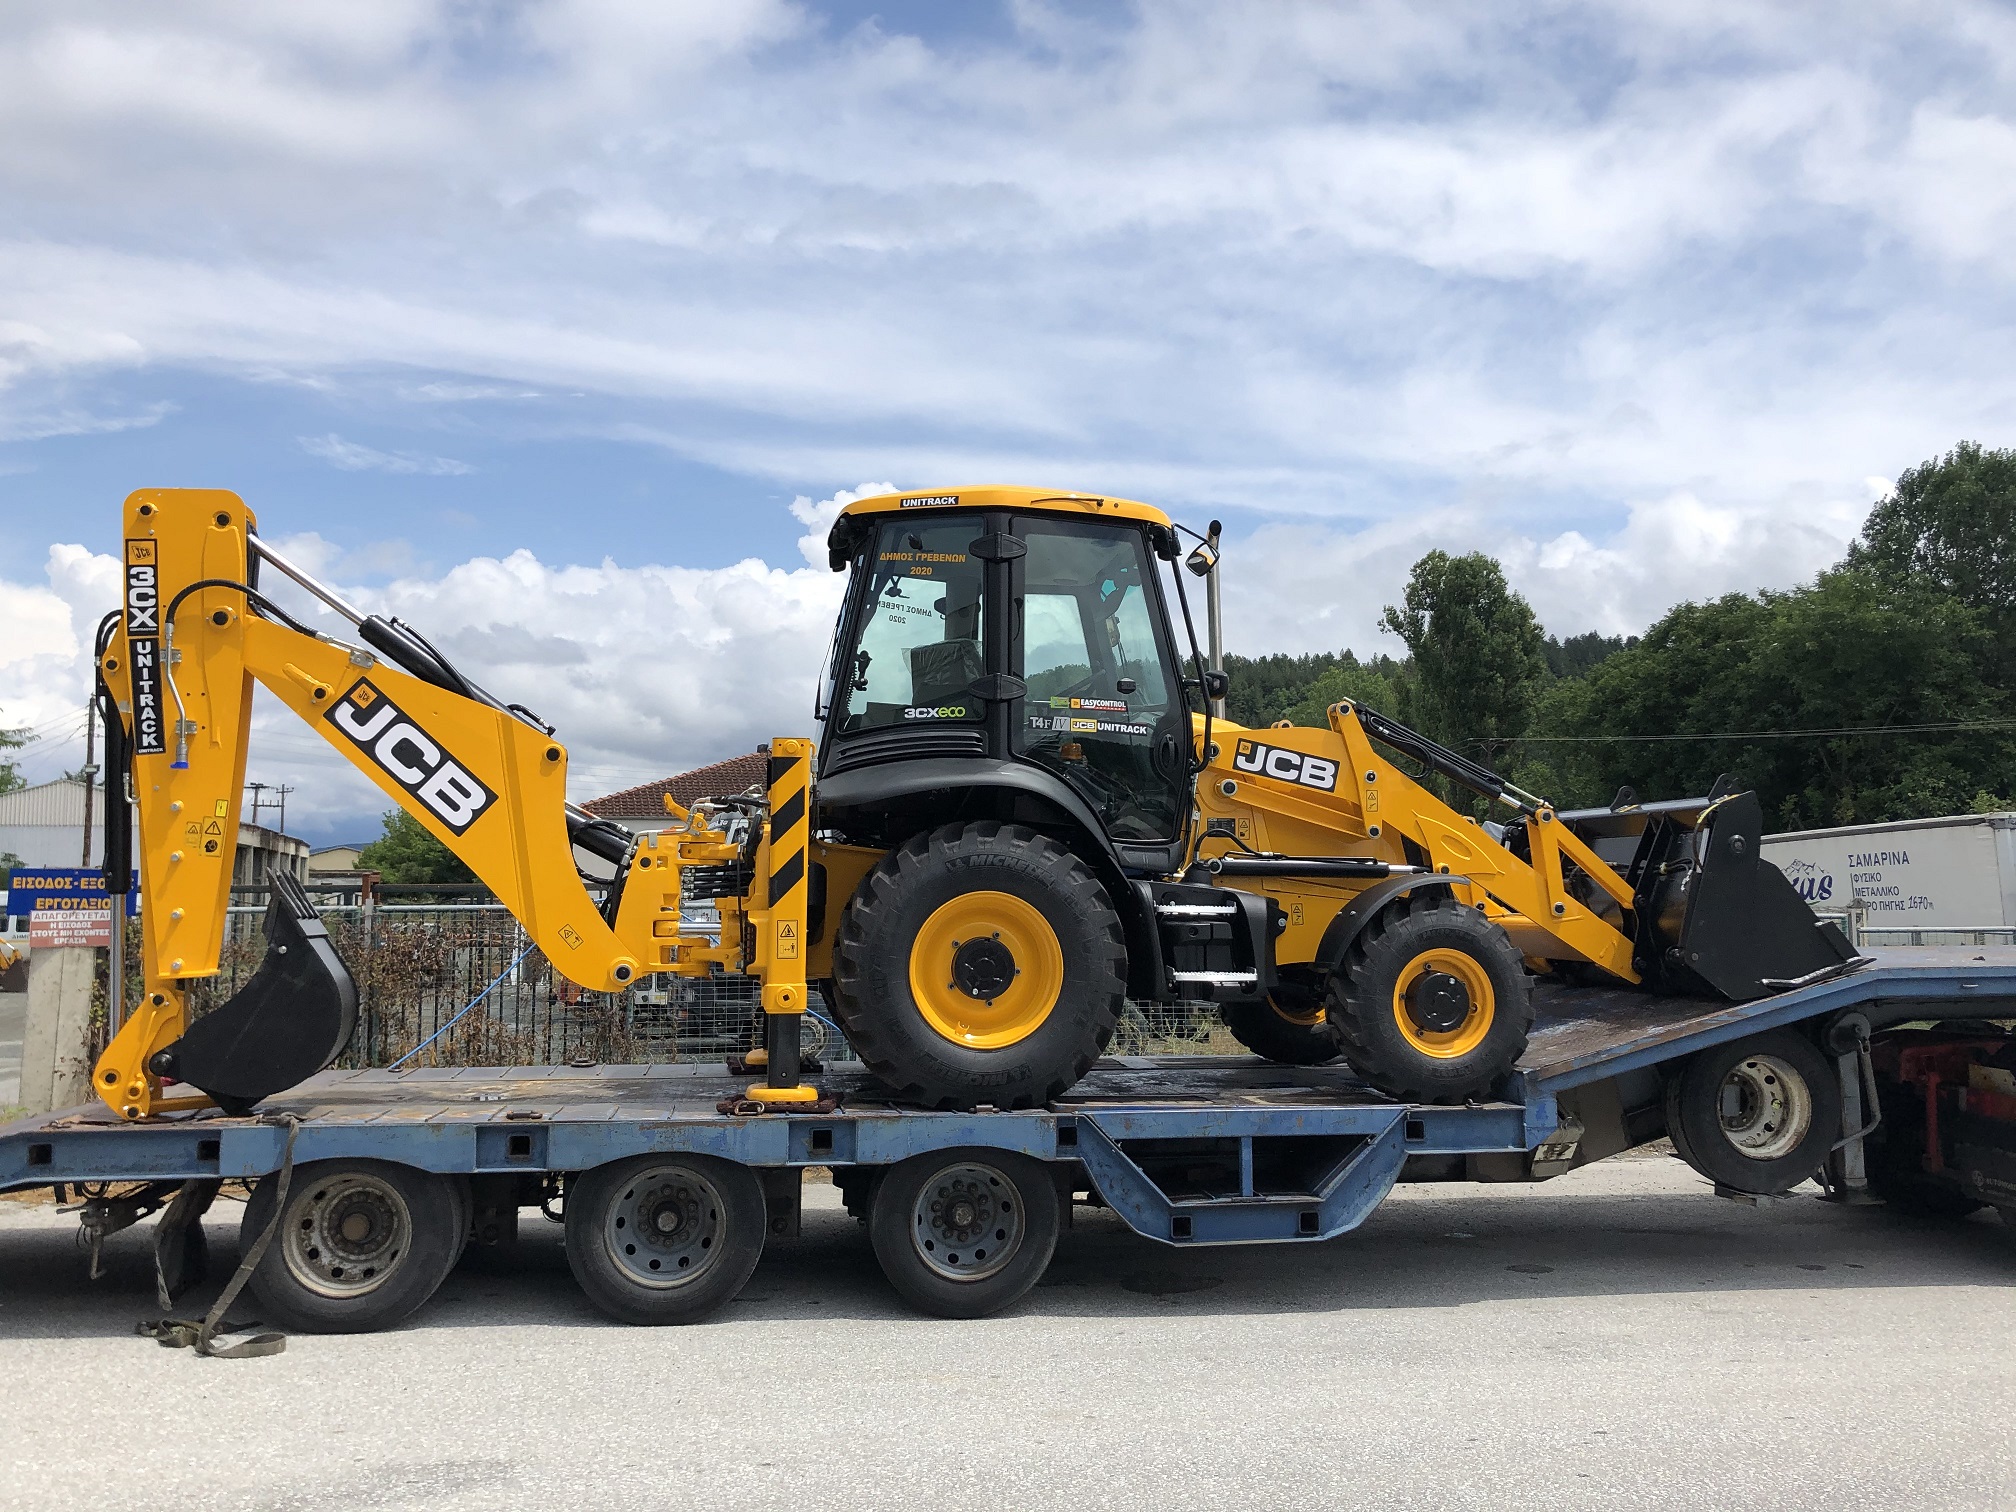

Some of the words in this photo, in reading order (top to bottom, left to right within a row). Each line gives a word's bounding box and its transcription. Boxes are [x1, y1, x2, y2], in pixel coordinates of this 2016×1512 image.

[902, 496, 956, 507] UNITRACK
[133, 546, 152, 560] JCB
[880, 552, 913, 561] ΔΗΜΟΣ
[915, 553, 966, 563] ΓΡΕΒΕΝΩΝ
[910, 566, 933, 575] 2020
[128, 566, 158, 628] 3CX
[136, 641, 158, 747] UNITRACK
[1080, 697, 1127, 708] EASYCONTROL
[904, 706, 966, 719] 3CXeco
[1072, 720, 1096, 730] JCB
[1097, 722, 1147, 735] UNITRACK
[334, 700, 487, 827] JCB
[1236, 745, 1336, 789] JCB
[1847, 850, 1911, 869] ΣΑΜΑΡΙΝΑ
[1852, 871, 1882, 883] ΦΥΣΙΚΟ
[1854, 885, 1900, 898] ΜΕΤΑΛΛΙΚΟ
[1880, 900, 1906, 911] ΠΗΓΗΣ
[34, 911, 110, 920] ΑΠΑΓΟΡΕΥΕΤΑΙ
[31, 929, 59, 937] ΣΤΟΥΣ
[74, 929, 110, 937] ΕΧΟΝΤΕΣ
[54, 937, 87, 945] ΕΡΓΑΣΙΑ
